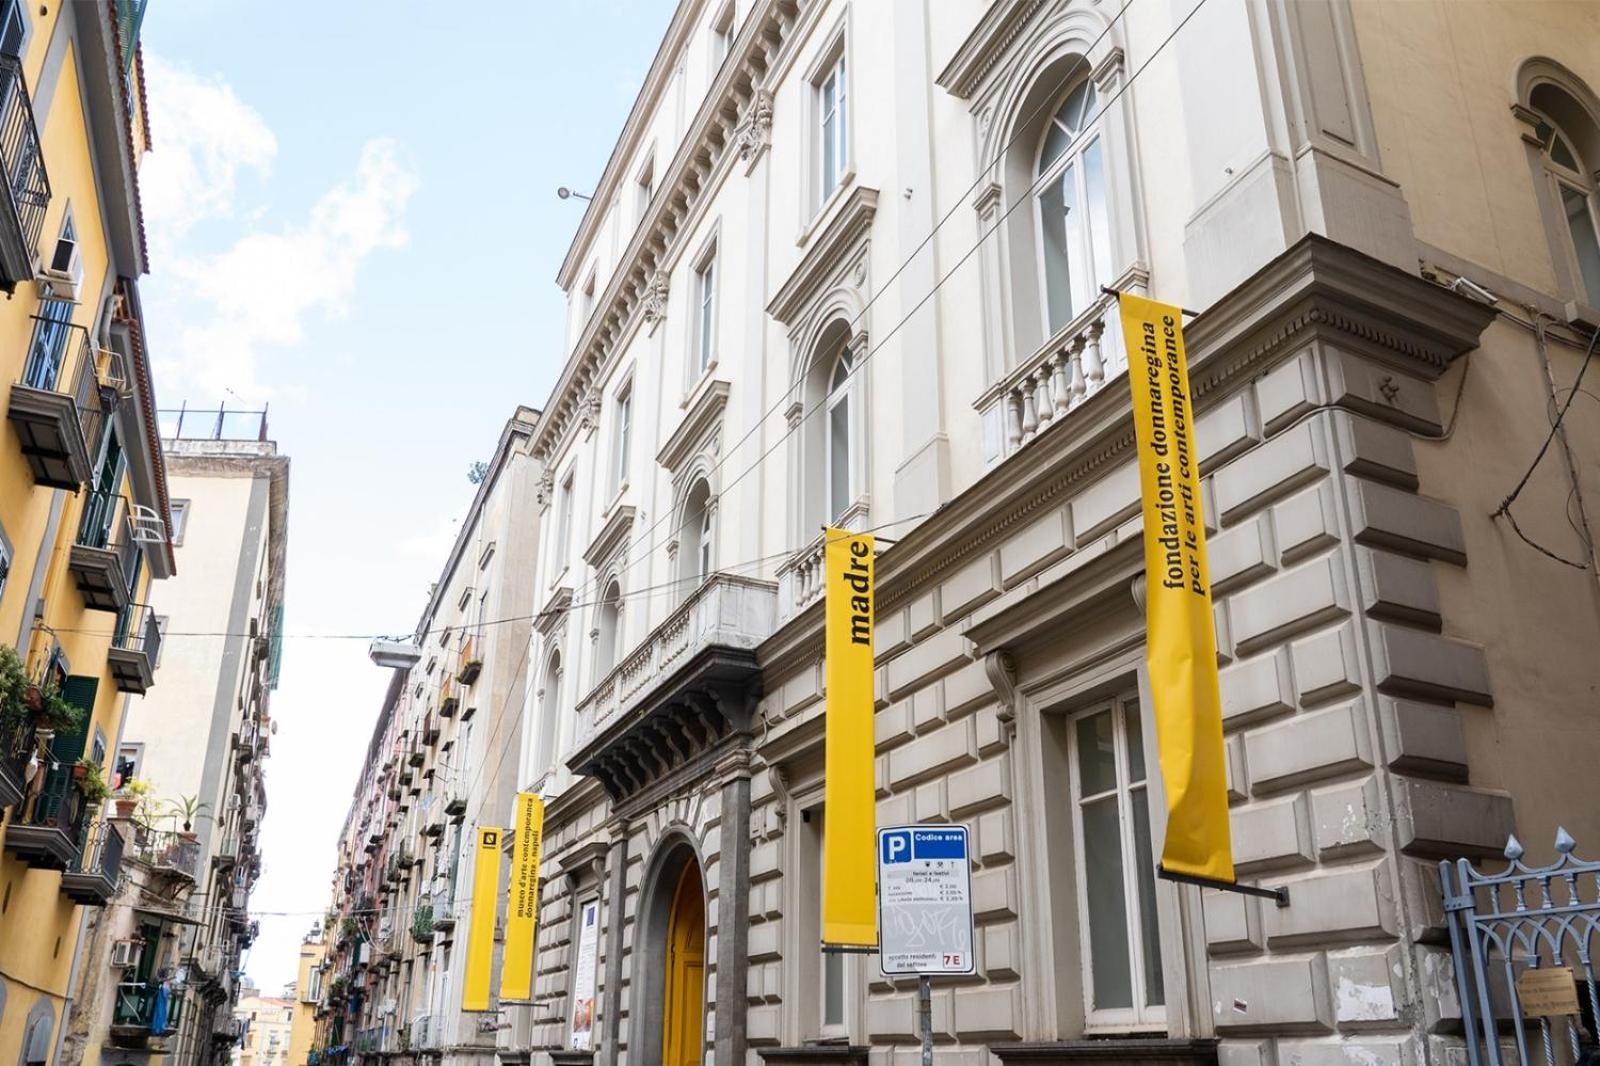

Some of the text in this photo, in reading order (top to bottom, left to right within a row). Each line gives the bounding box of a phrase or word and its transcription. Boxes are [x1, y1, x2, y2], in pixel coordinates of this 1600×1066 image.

[1141, 322, 1185, 589] fondazione donnaregina
[1162, 315, 1206, 597] per le arti contemporanee
[843, 541, 871, 647] madre
[517, 889, 526, 918] museo
[522, 798, 534, 862] contemporanea
[531, 830, 540, 858] napoli
[888, 836, 906, 861] P
[914, 833, 963, 842] Codice area
[525, 865, 538, 919] donnaregina
